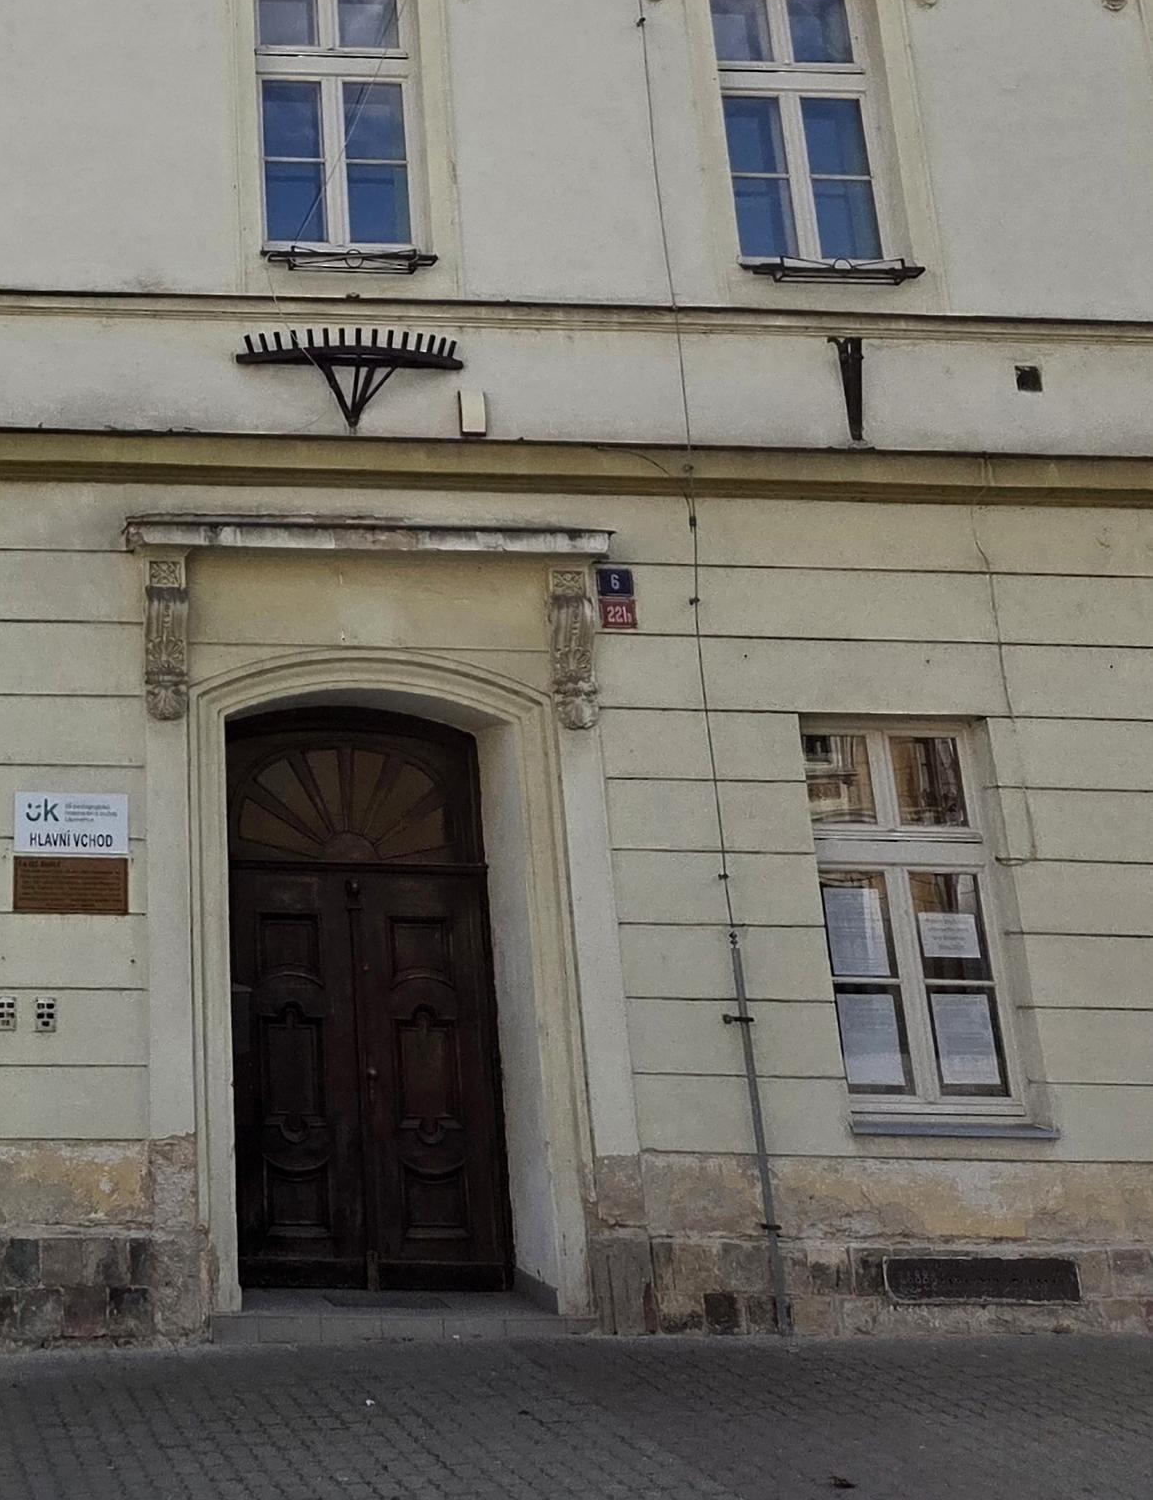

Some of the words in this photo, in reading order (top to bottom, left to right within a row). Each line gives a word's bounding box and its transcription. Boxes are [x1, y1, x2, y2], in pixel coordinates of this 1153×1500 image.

[610, 573, 620, 590] 6
[30, 830, 71, 848] HLAVNÍ
[74, 833, 114, 848] VCHOD
